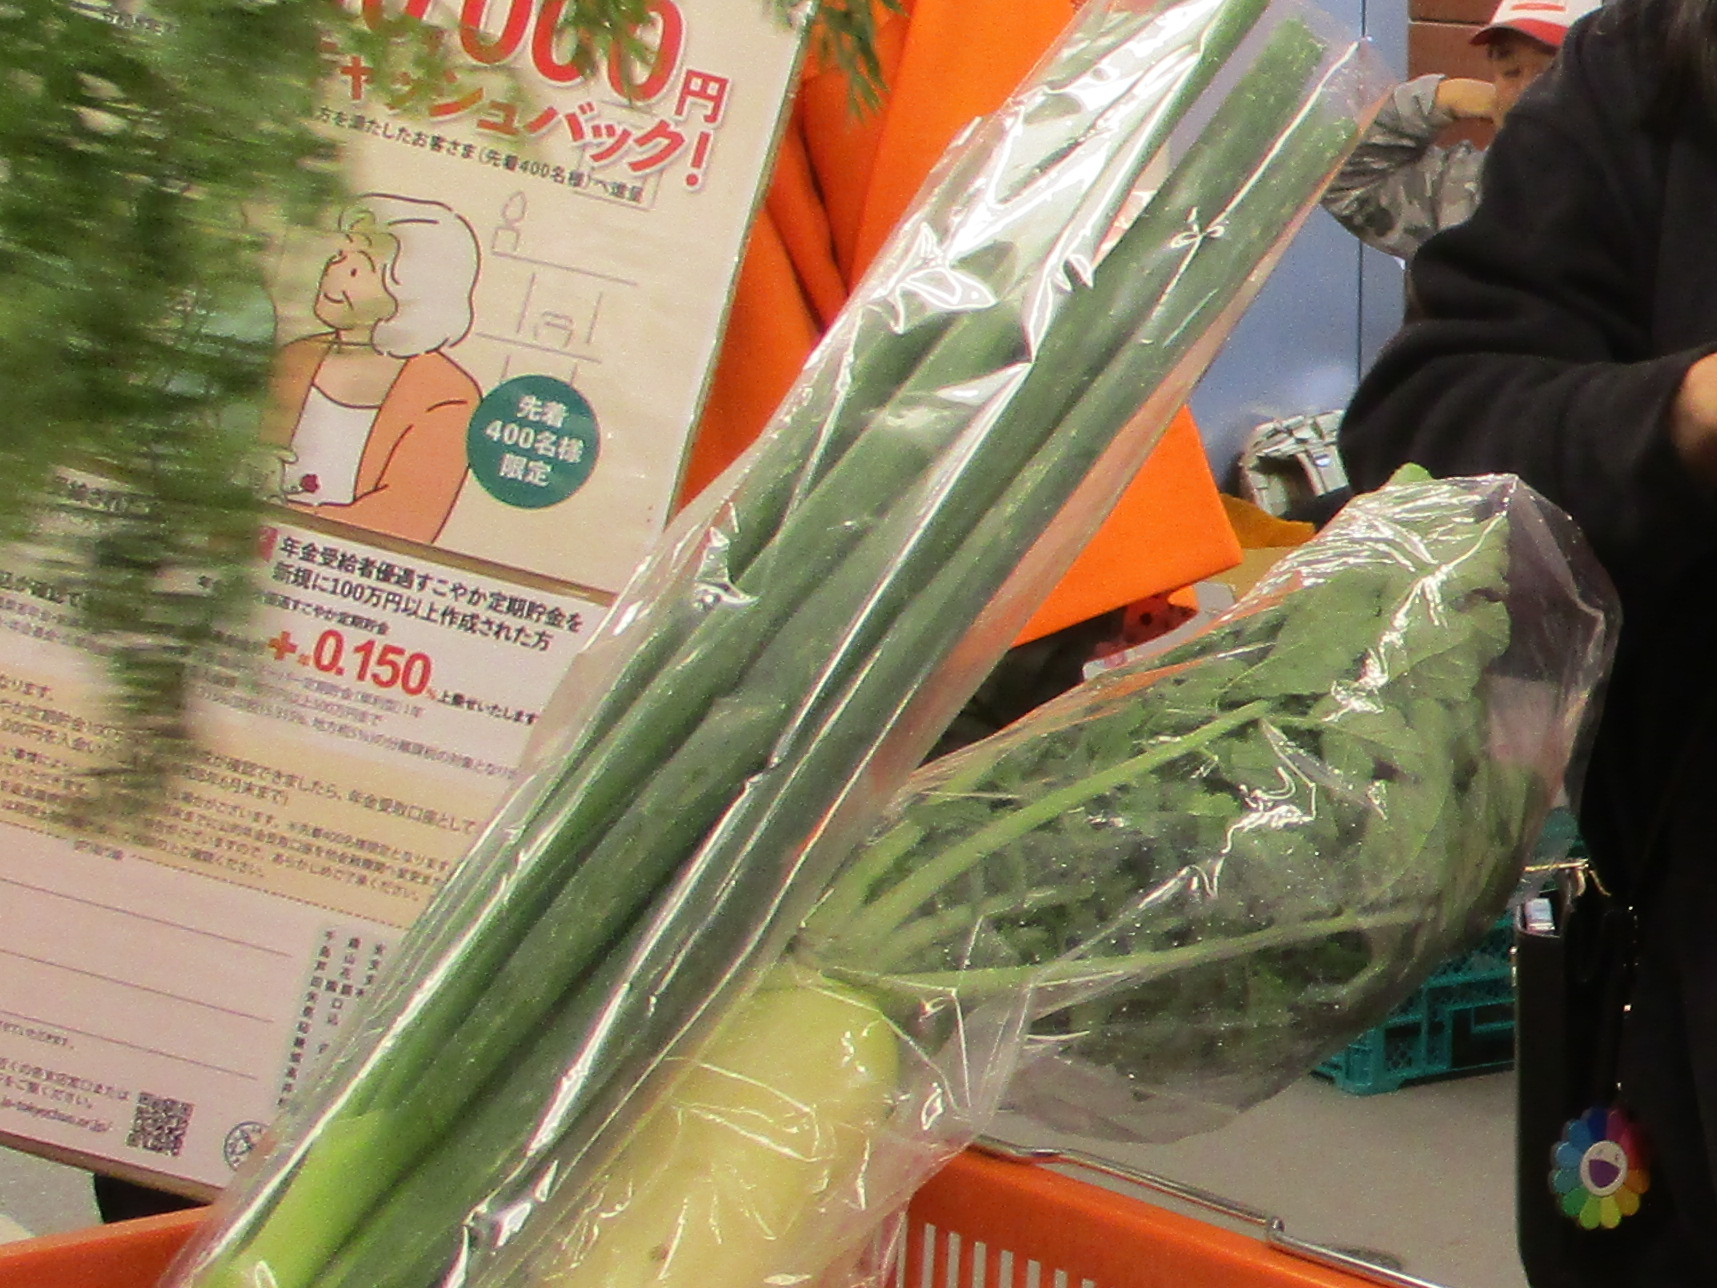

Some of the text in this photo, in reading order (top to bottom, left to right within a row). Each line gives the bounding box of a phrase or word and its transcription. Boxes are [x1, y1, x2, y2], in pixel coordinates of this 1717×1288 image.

[516, 394, 568, 428] 先着
[484, 419, 585, 463] 400名様
[499, 452, 552, 487] 限定
